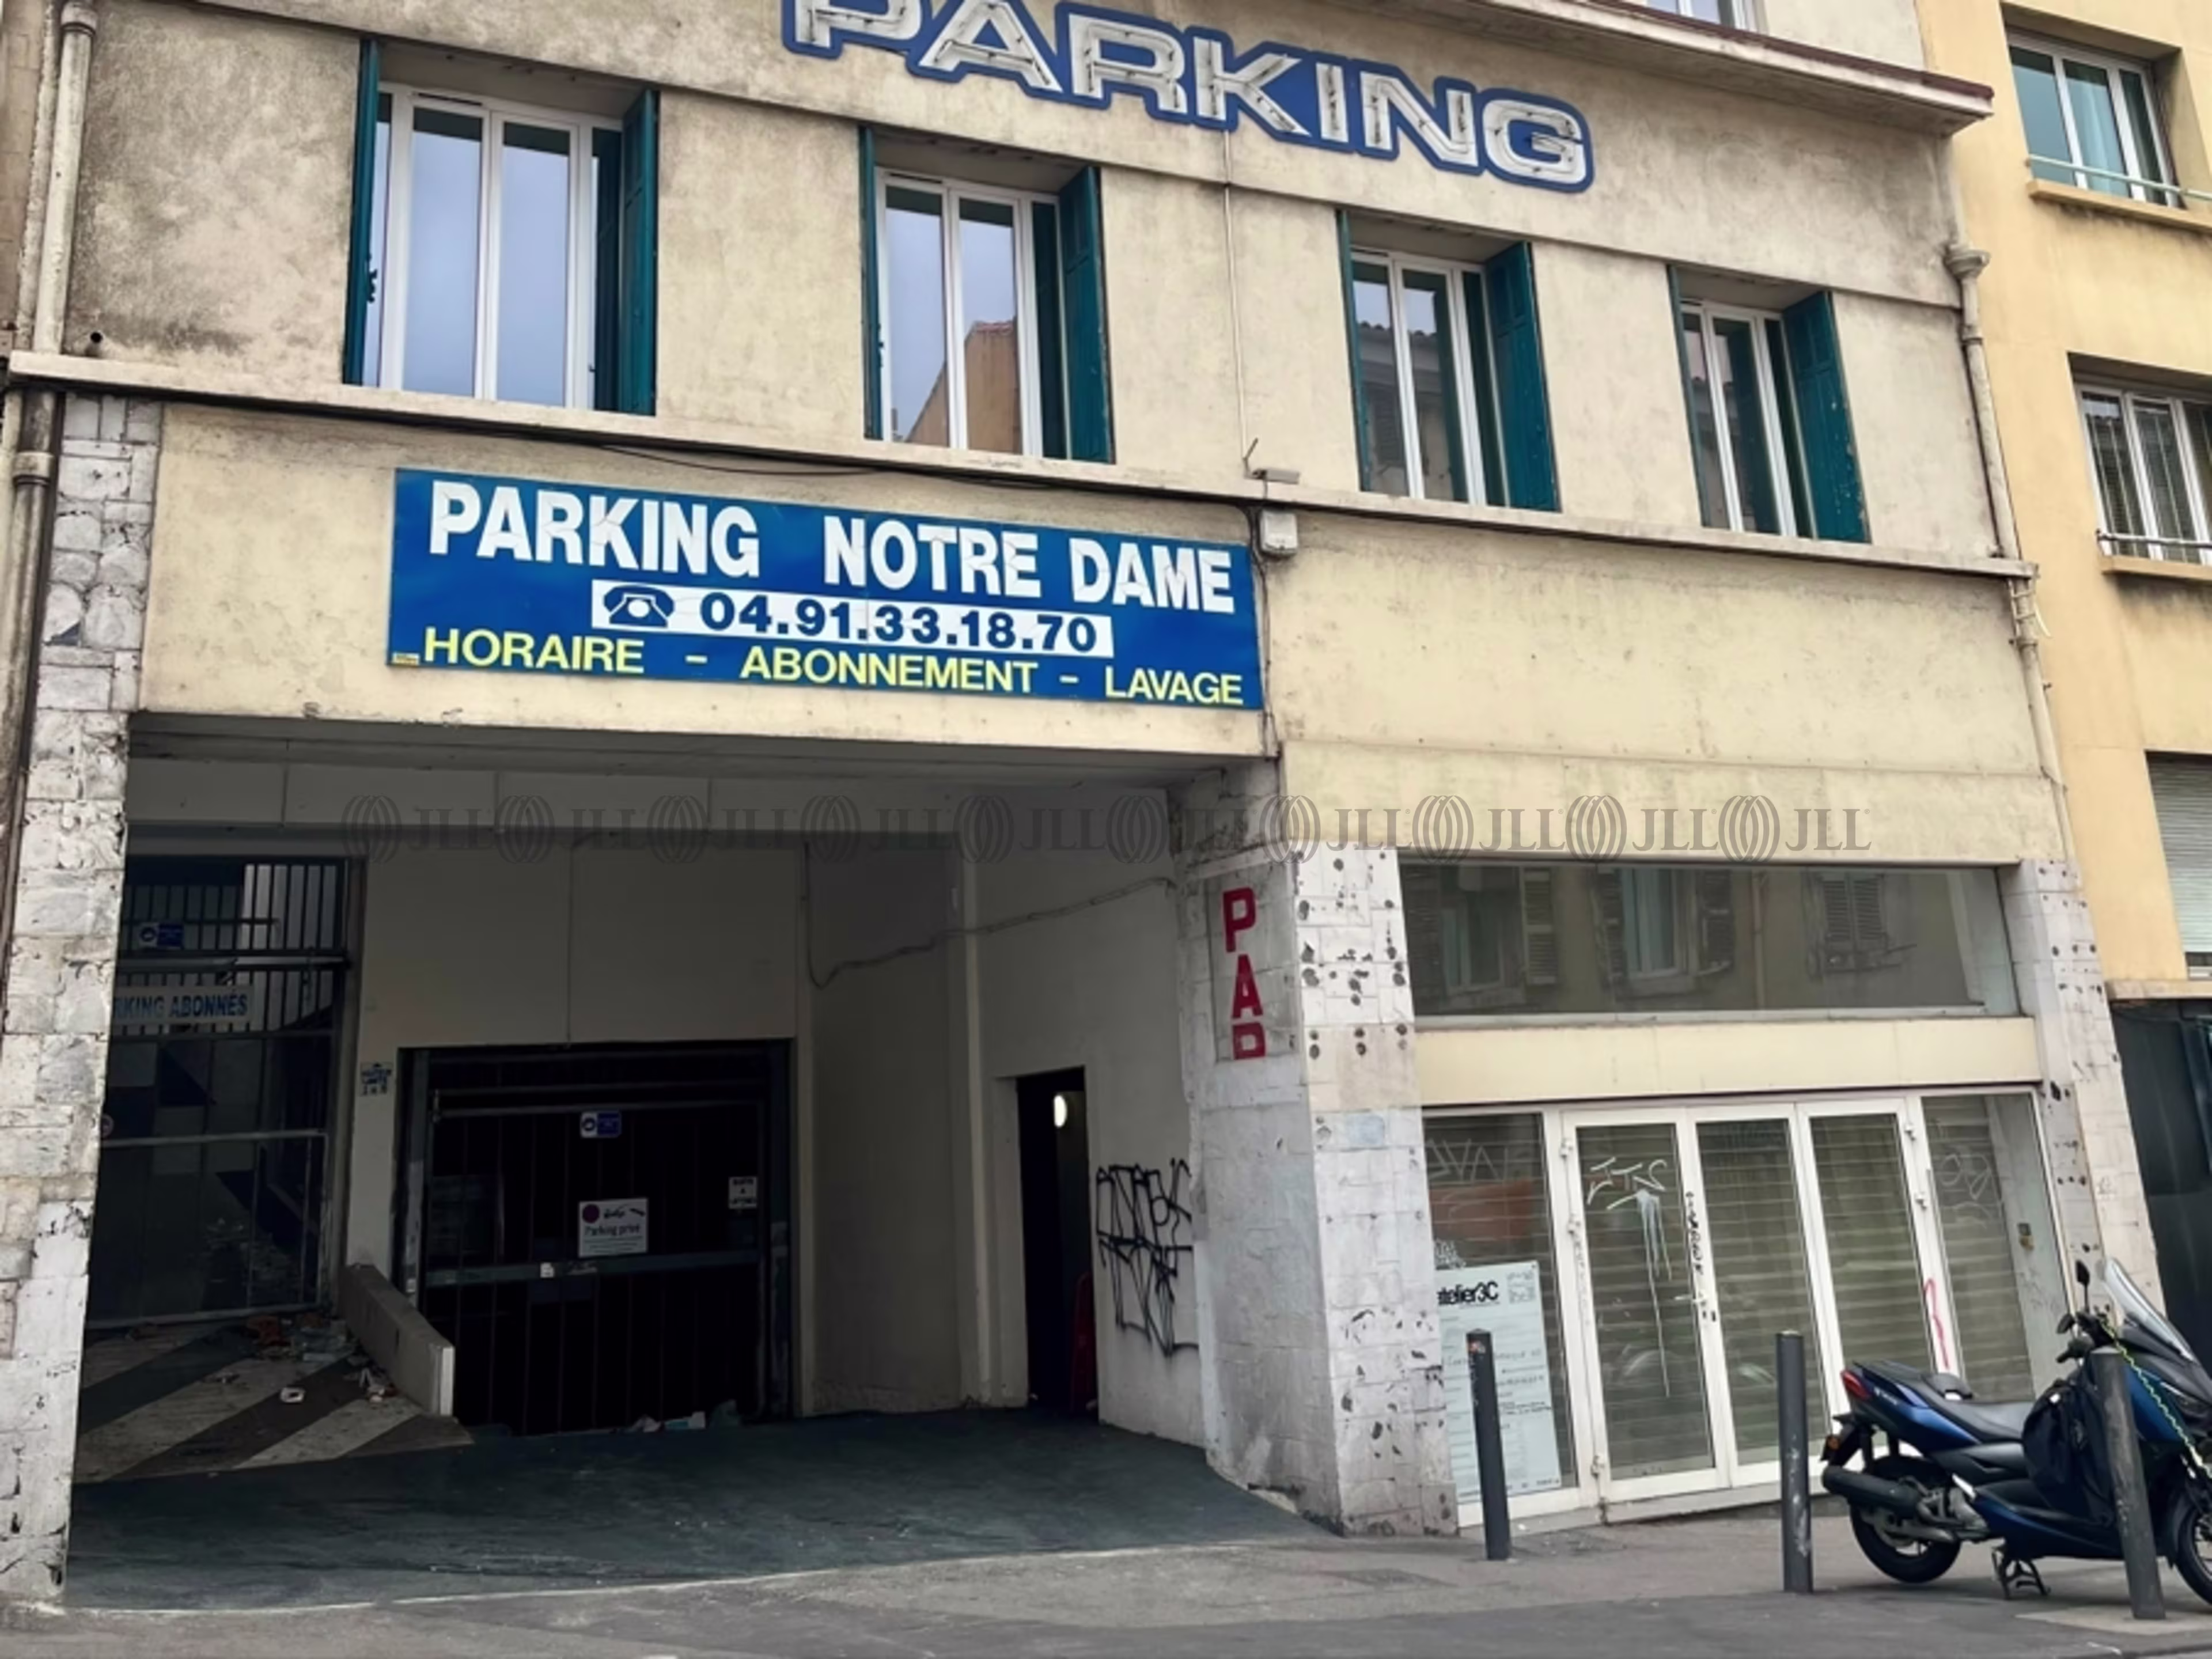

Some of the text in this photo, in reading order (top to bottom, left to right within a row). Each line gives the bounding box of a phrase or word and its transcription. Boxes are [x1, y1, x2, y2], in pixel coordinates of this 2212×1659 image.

[794, 0, 1587, 184] PARKING
[429, 480, 1235, 615] PARKING NOTRE DAME
[425, 626, 645, 674] HORAIRE
[739, 645, 1039, 694] ABONNEMENT
[1105, 665, 1244, 706] LAVAGE
[700, 592, 1097, 653] 04.91.33.18.70
